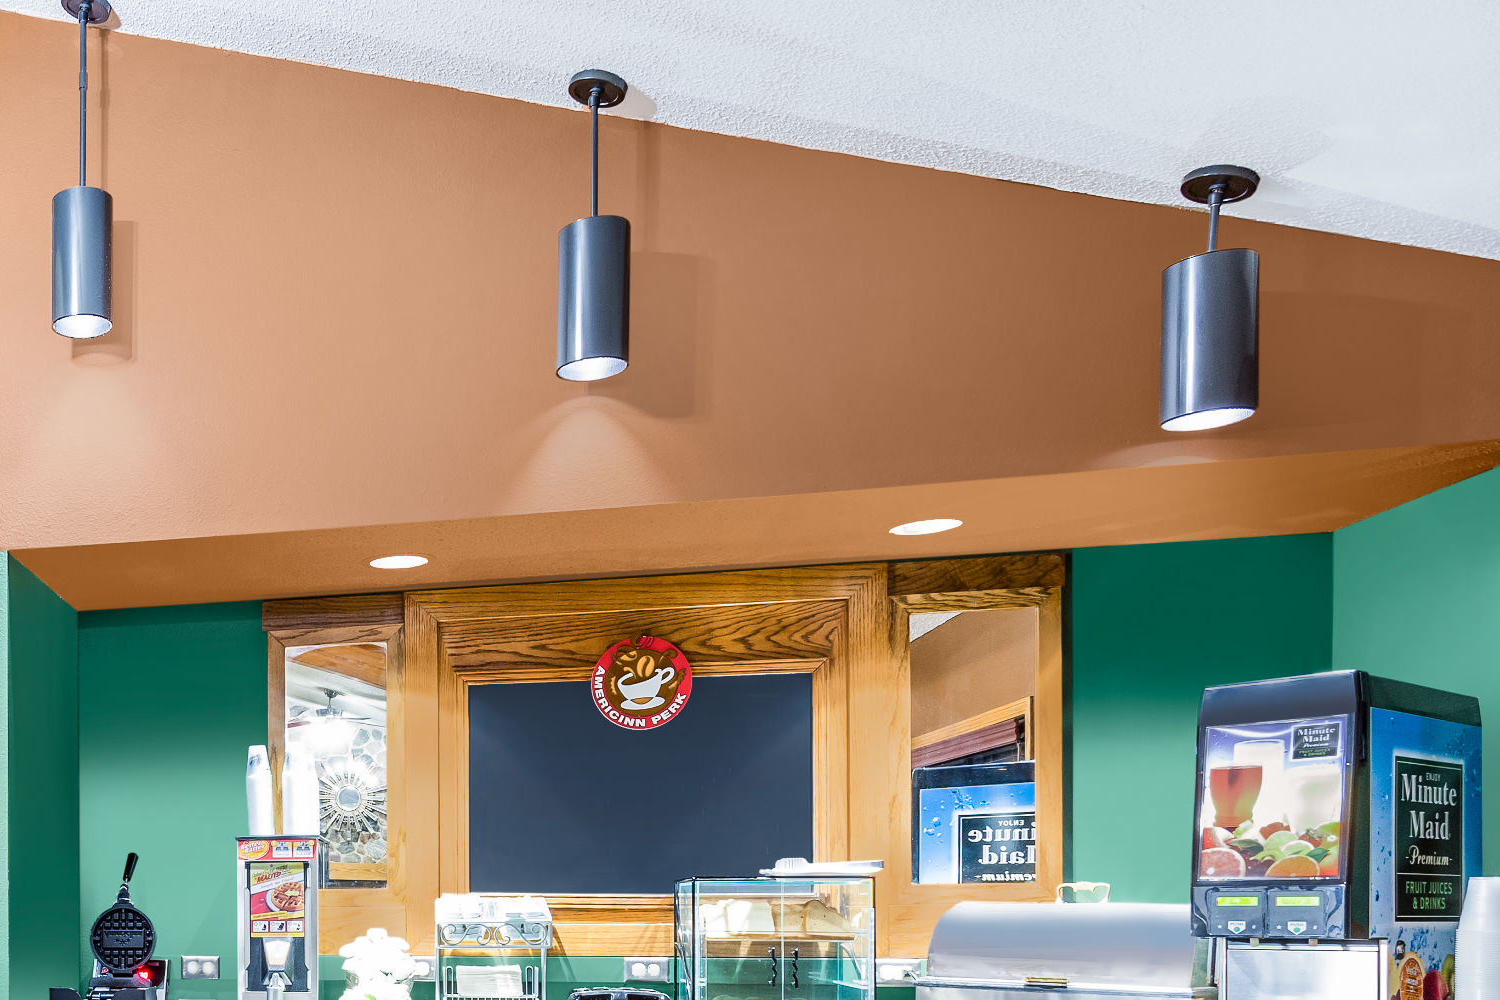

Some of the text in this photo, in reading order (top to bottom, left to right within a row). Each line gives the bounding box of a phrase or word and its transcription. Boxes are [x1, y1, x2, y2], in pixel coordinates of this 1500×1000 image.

[593, 665, 687, 727] AMERICINN PERK
[1297, 727, 1336, 738] Minute
[1302, 734, 1330, 743] Maid
[1425, 772, 1441, 782] ENJOY
[1400, 773, 1457, 806] Minute
[1408, 810, 1450, 840] Maid
[1405, 880, 1453, 895] FRUIT JUICES
[1412, 897, 1446, 910] & DRINKS
